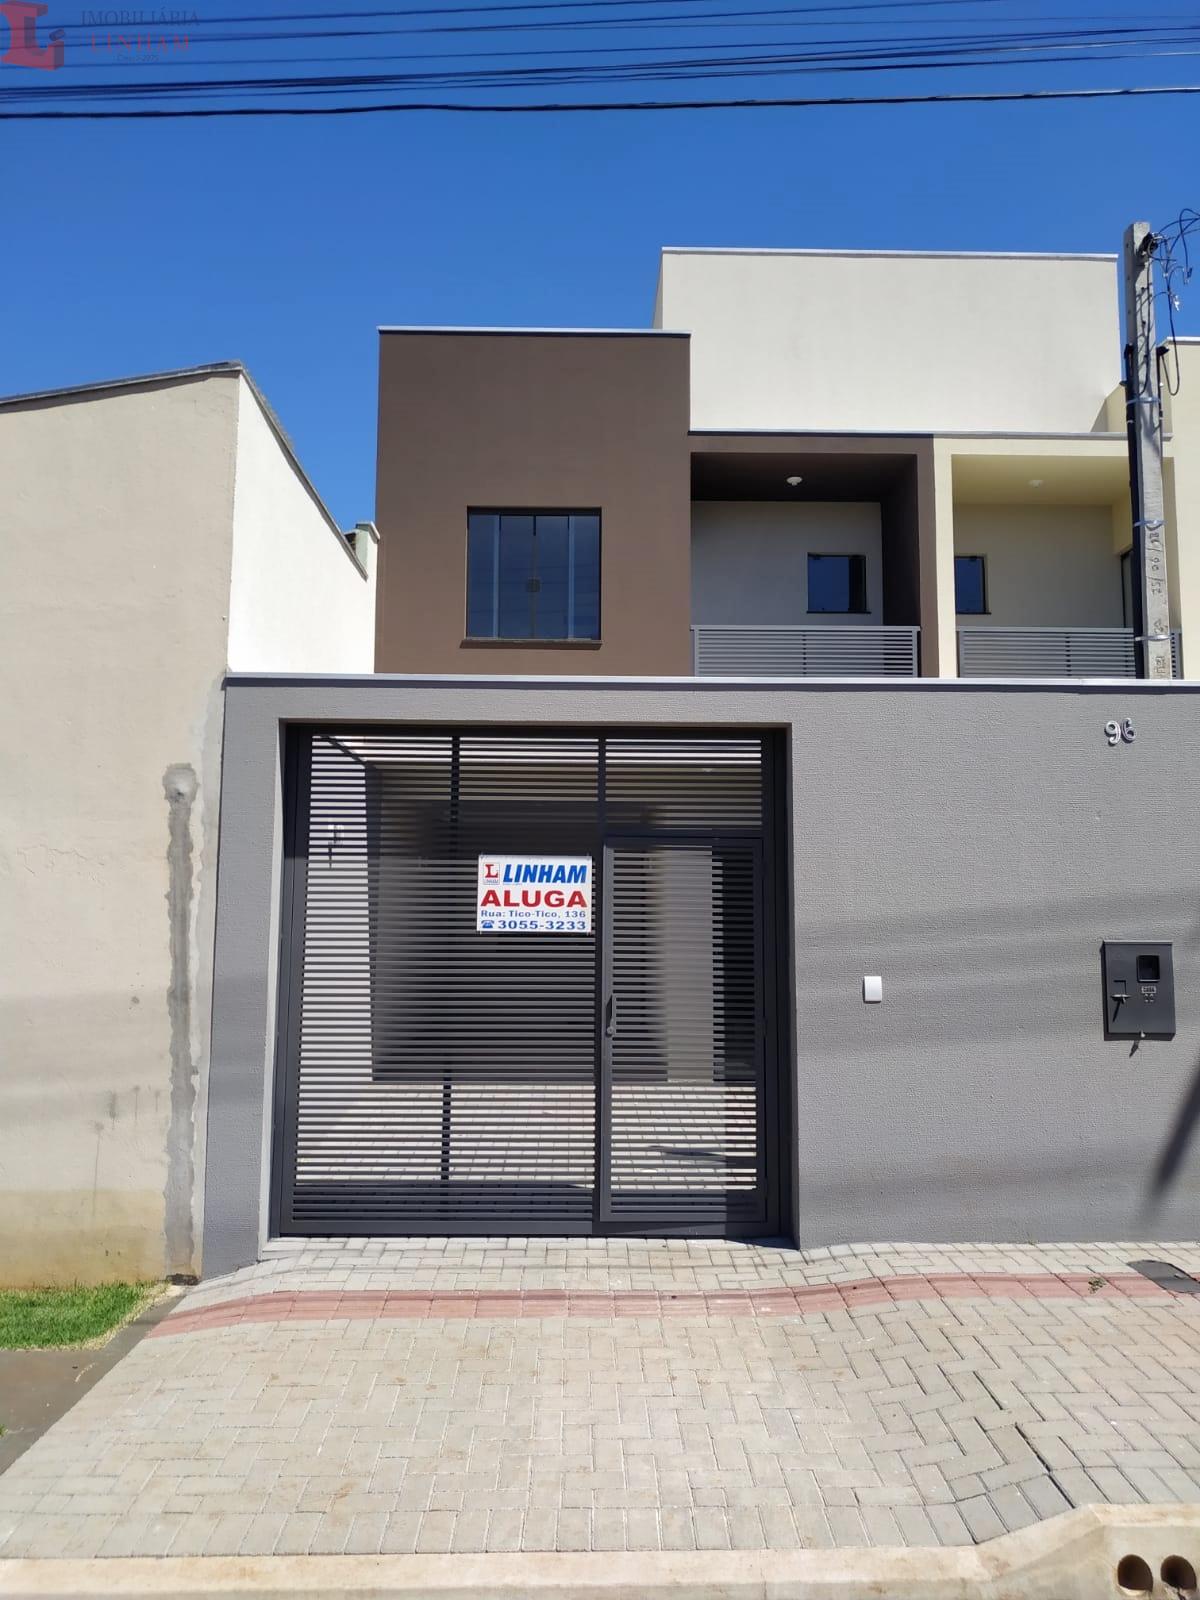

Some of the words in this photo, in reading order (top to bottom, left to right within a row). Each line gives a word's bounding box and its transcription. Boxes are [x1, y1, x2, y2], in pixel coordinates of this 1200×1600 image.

[1105, 717, 1137, 746] 96
[503, 864, 587, 883] LINHAM
[480, 889, 587, 907] ALUGA
[509, 910, 561, 918] Tico-Tico,
[565, 910, 586, 918] 136
[498, 920, 586, 930] 3055-3233
